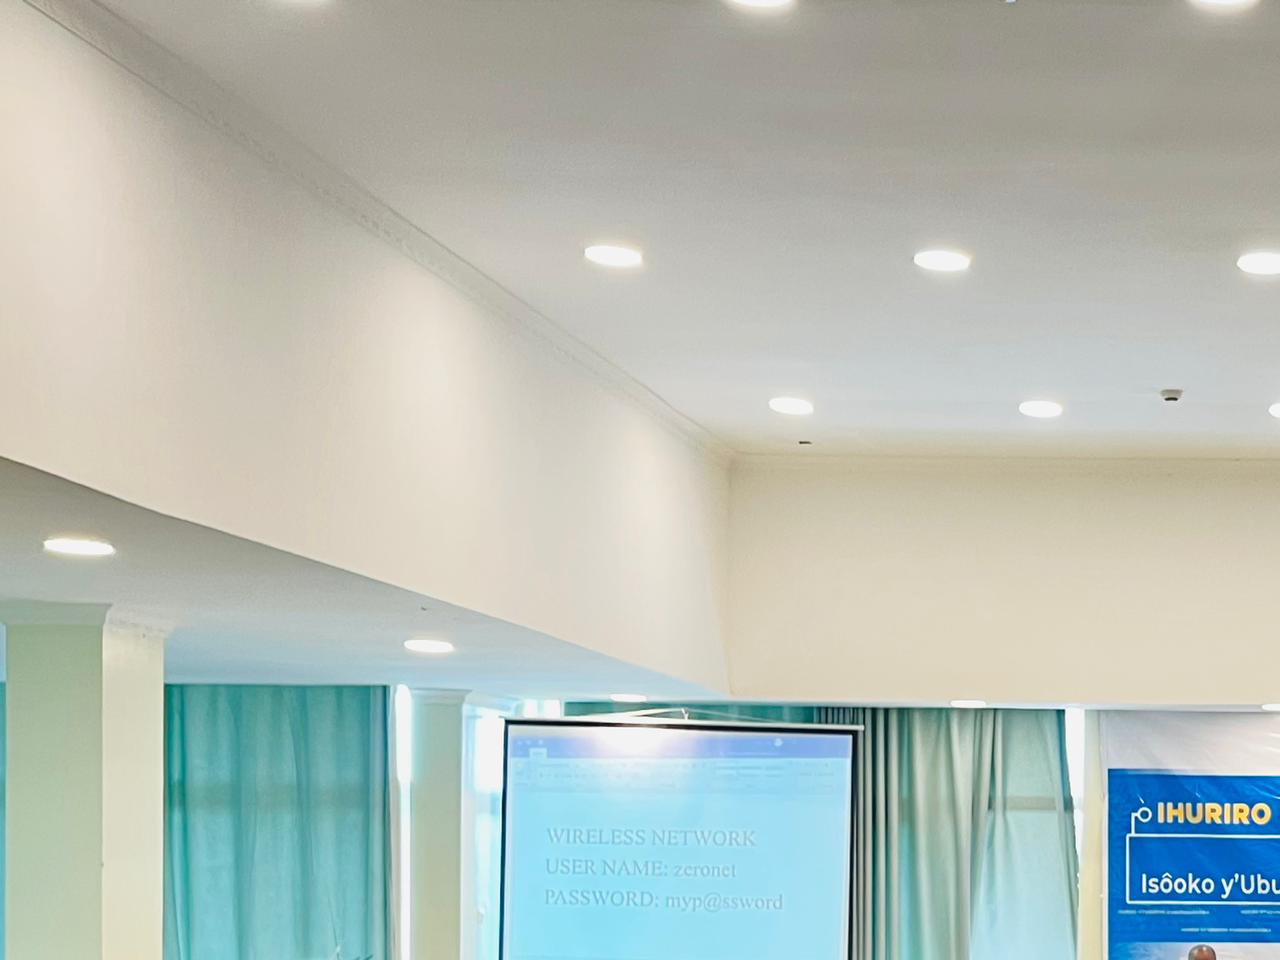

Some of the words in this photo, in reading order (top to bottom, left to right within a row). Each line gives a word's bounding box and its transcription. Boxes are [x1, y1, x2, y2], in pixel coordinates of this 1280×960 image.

[1157, 802, 1272, 824] IHURIRO
[546, 828, 646, 846] WIRELESS
[652, 829, 756, 847] NETWORK
[545, 858, 597, 876] USER
[601, 859, 669, 877] NAME:
[1141, 871, 1215, 894] Isôoko
[544, 888, 660, 908] PASSWORD:
[665, 892, 784, 914] myp@ssword
